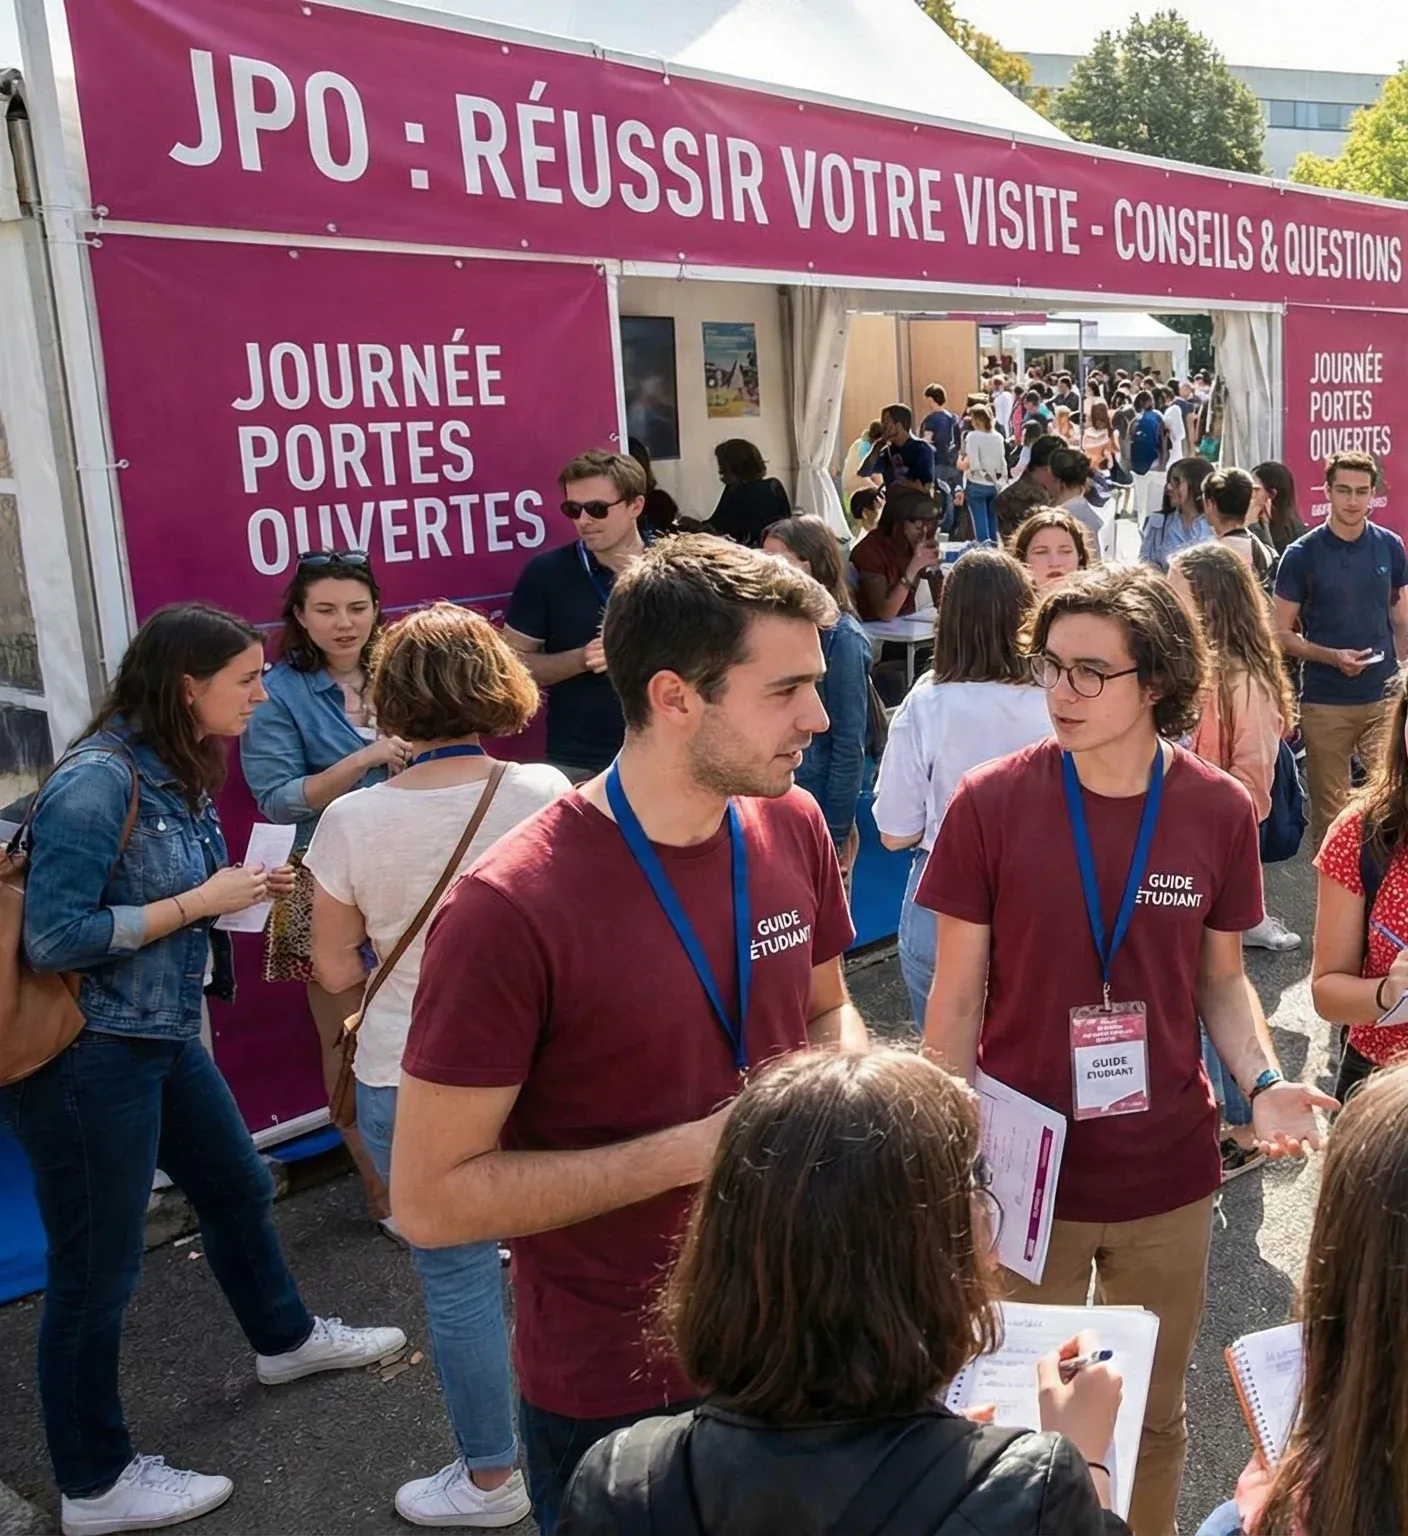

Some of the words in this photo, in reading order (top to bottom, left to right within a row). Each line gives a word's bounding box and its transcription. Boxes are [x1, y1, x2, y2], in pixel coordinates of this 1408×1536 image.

[169, 48, 369, 182] JPO
[405, 122, 429, 190] :
[455, 80, 769, 225] RÉUSSIR
[780, 145, 945, 243] VOTRE
[953, 173, 1081, 255] VISITE
[1114, 198, 1254, 271] CONSEILS
[1260, 219, 1279, 273] &
[1284, 223, 1402, 283] QUESTIONS
[231, 328, 506, 411] JOURNÉE
[1309, 344, 1383, 384] JOURNÉE
[1310, 389, 1373, 423] PORTES
[238, 420, 474, 494] PORTES
[247, 489, 546, 576] OUVERTES
[1148, 873, 1194, 890] GUIDE
[757, 909, 801, 936] GUIDE
[750, 924, 812, 961] ÉTUDIANT
[1091, 1055, 1129, 1069] GUIDE
